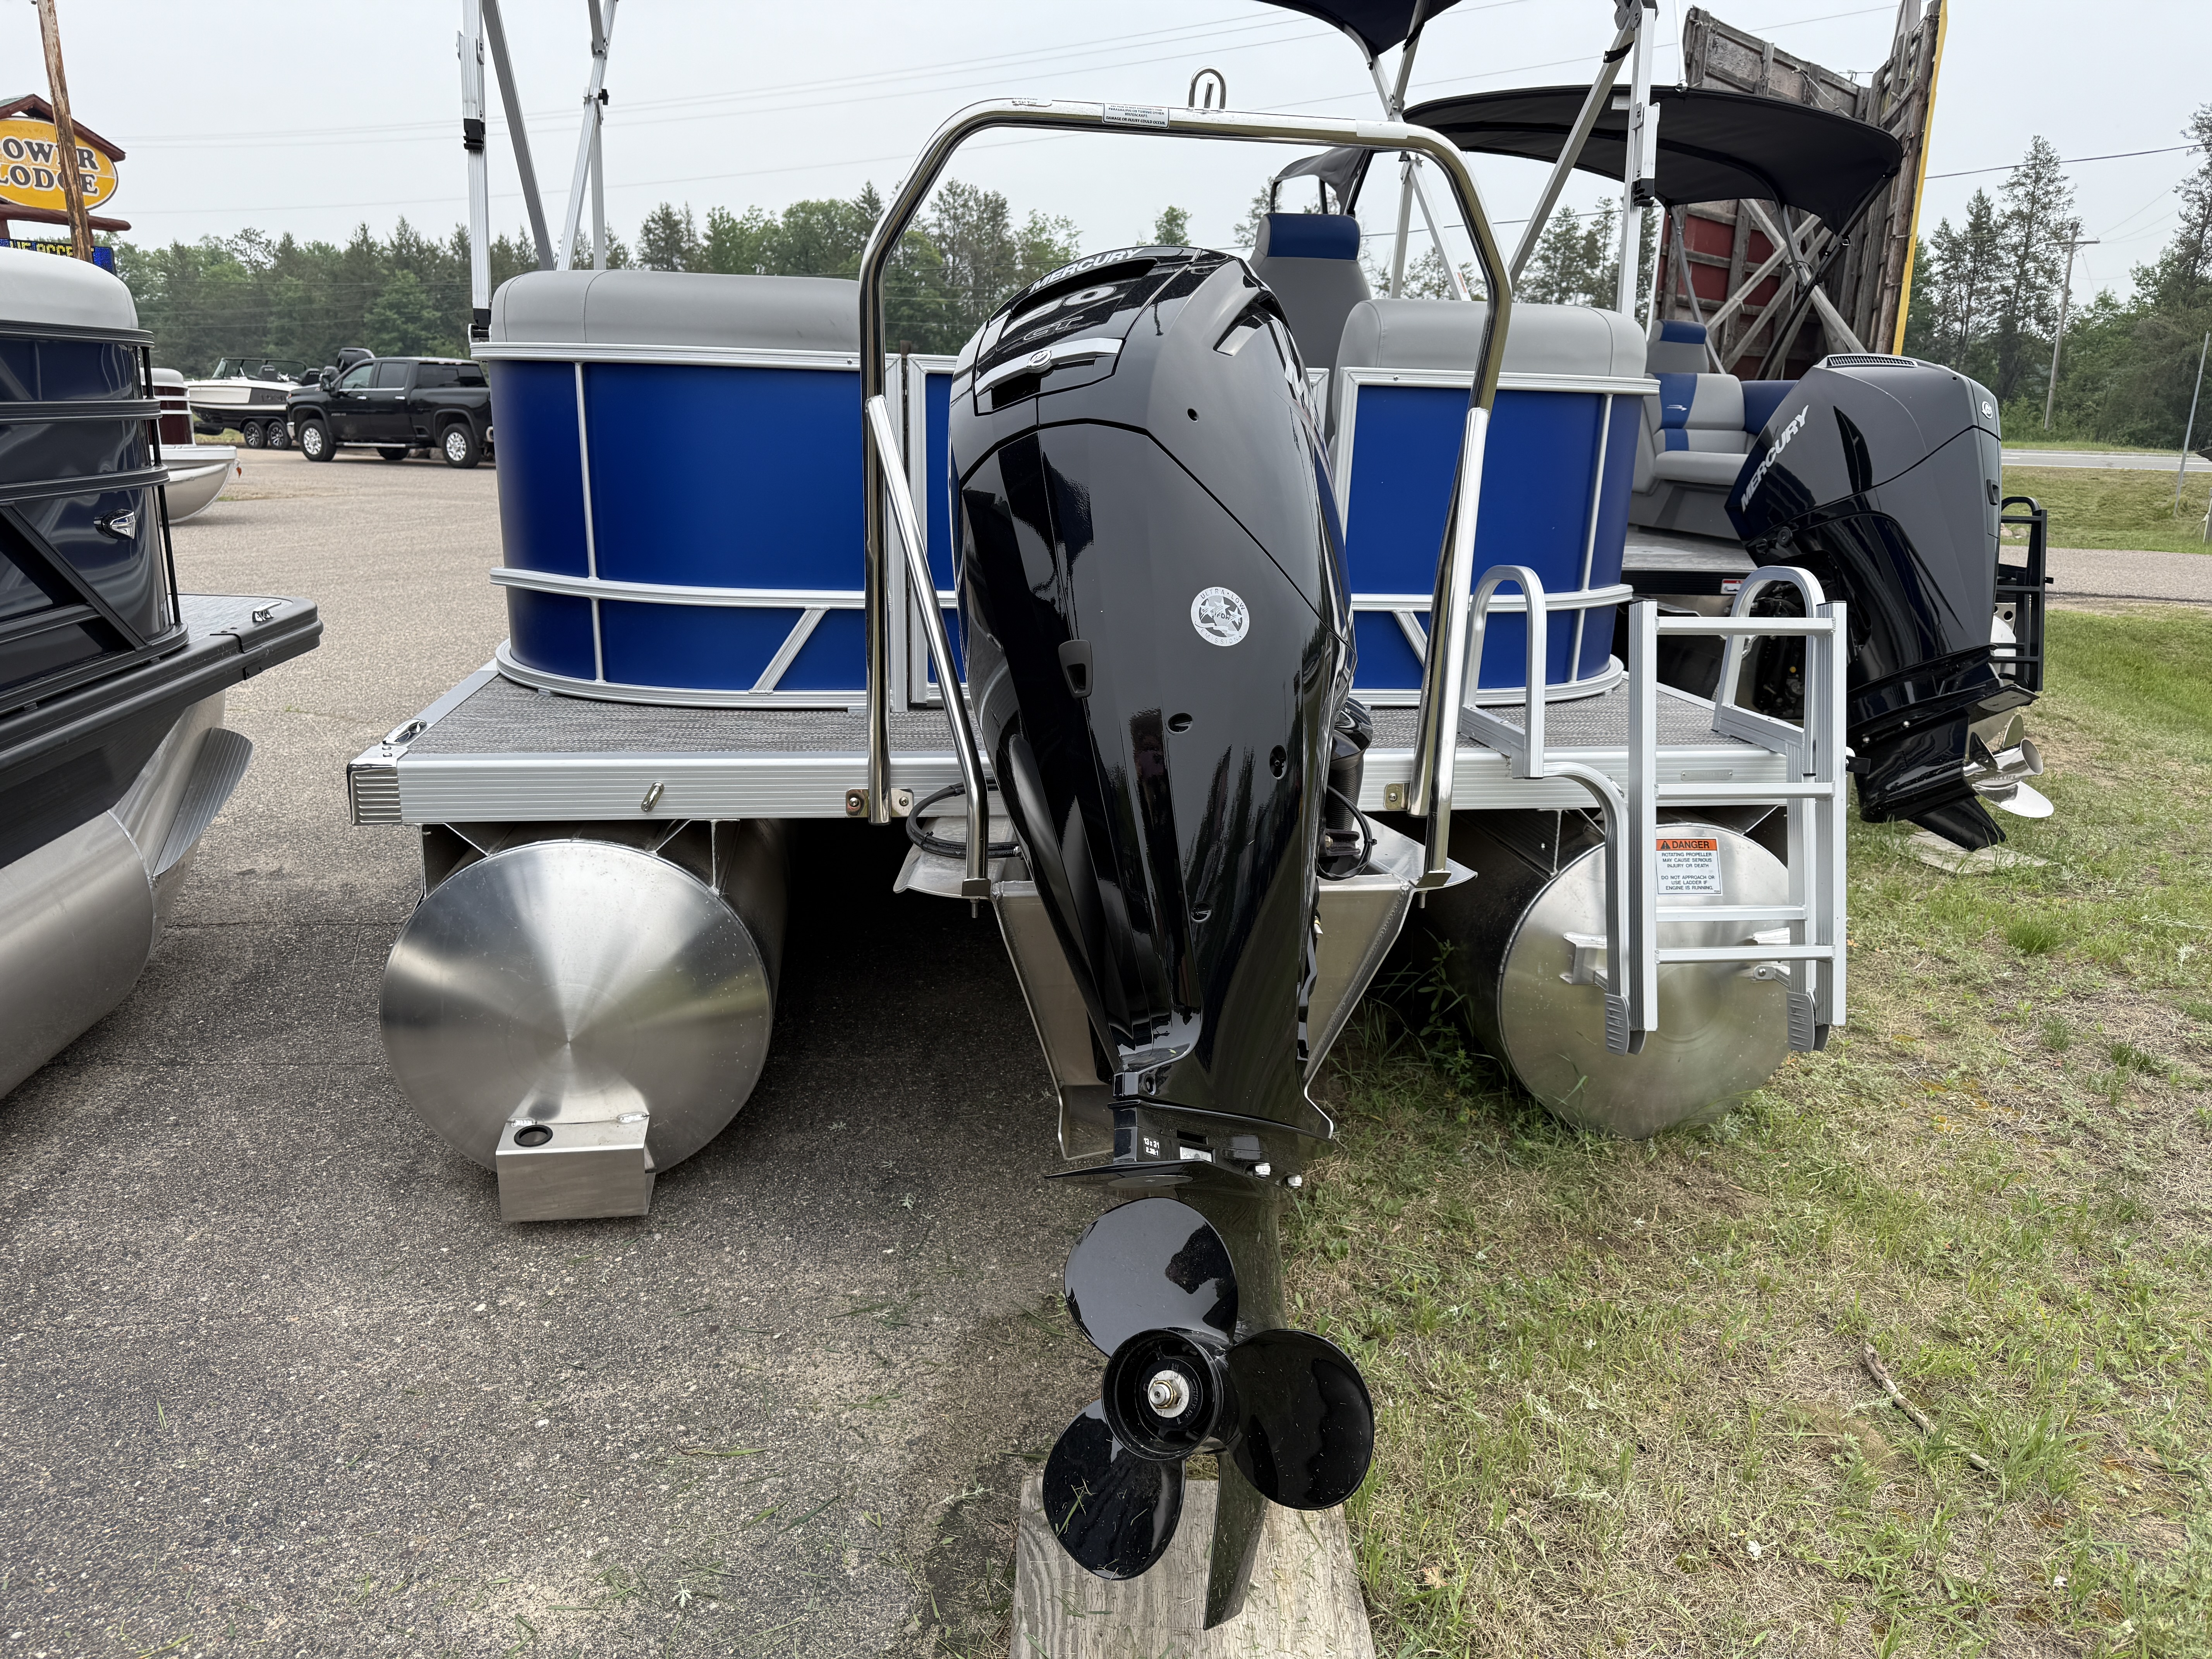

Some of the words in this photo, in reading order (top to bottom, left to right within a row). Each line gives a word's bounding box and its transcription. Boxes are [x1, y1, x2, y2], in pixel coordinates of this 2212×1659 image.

[0, 137, 98, 170] OWR
[0, 165, 98, 194] ODE
[1028, 248, 1144, 294] MERCURY
[1741, 405, 1809, 514] MERCURY
[1200, 589, 1224, 599] ULTRA
[1231, 594, 1245, 610] LOW
